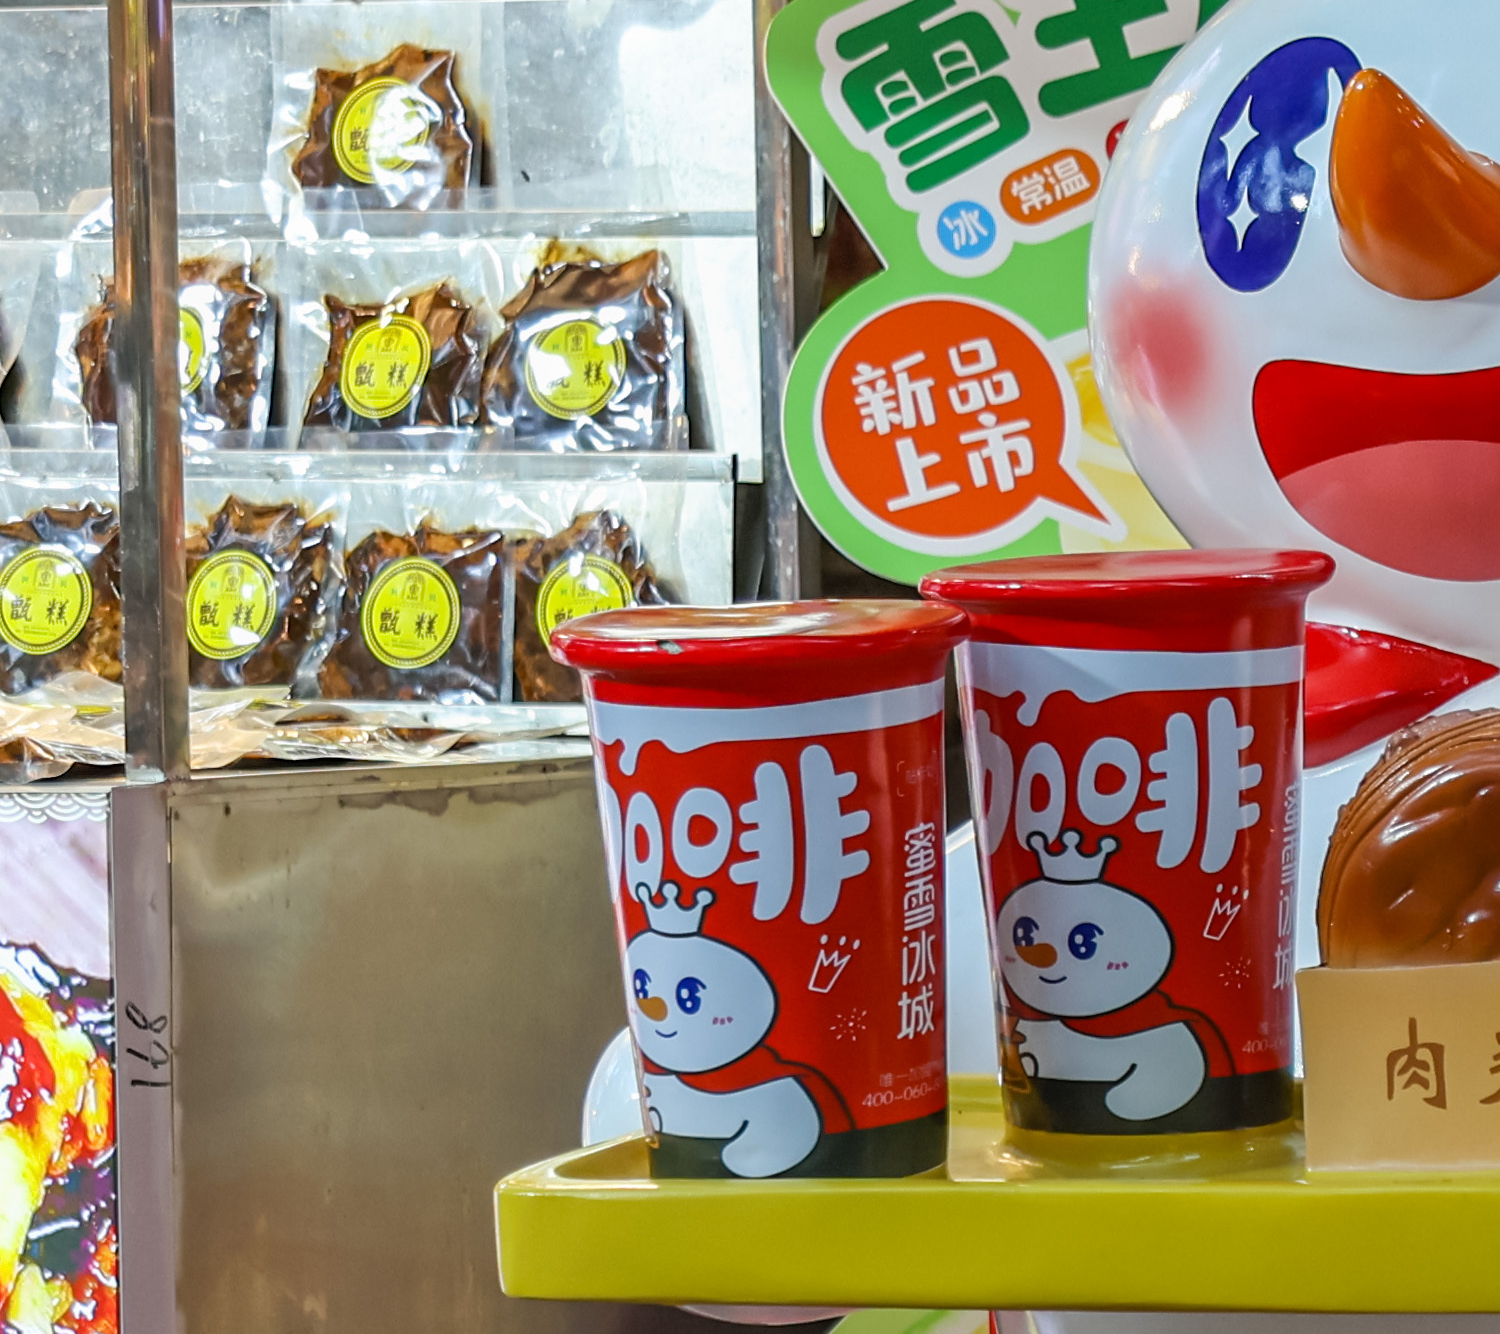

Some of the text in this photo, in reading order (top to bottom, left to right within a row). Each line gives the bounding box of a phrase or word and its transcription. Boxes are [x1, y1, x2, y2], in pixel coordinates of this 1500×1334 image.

[944, 208, 990, 252] 冰
[1010, 154, 1093, 216] 常温
[852, 336, 1022, 437] 新品
[885, 414, 1035, 513] 上市
[896, 821, 937, 1040] 蜜雪冰城
